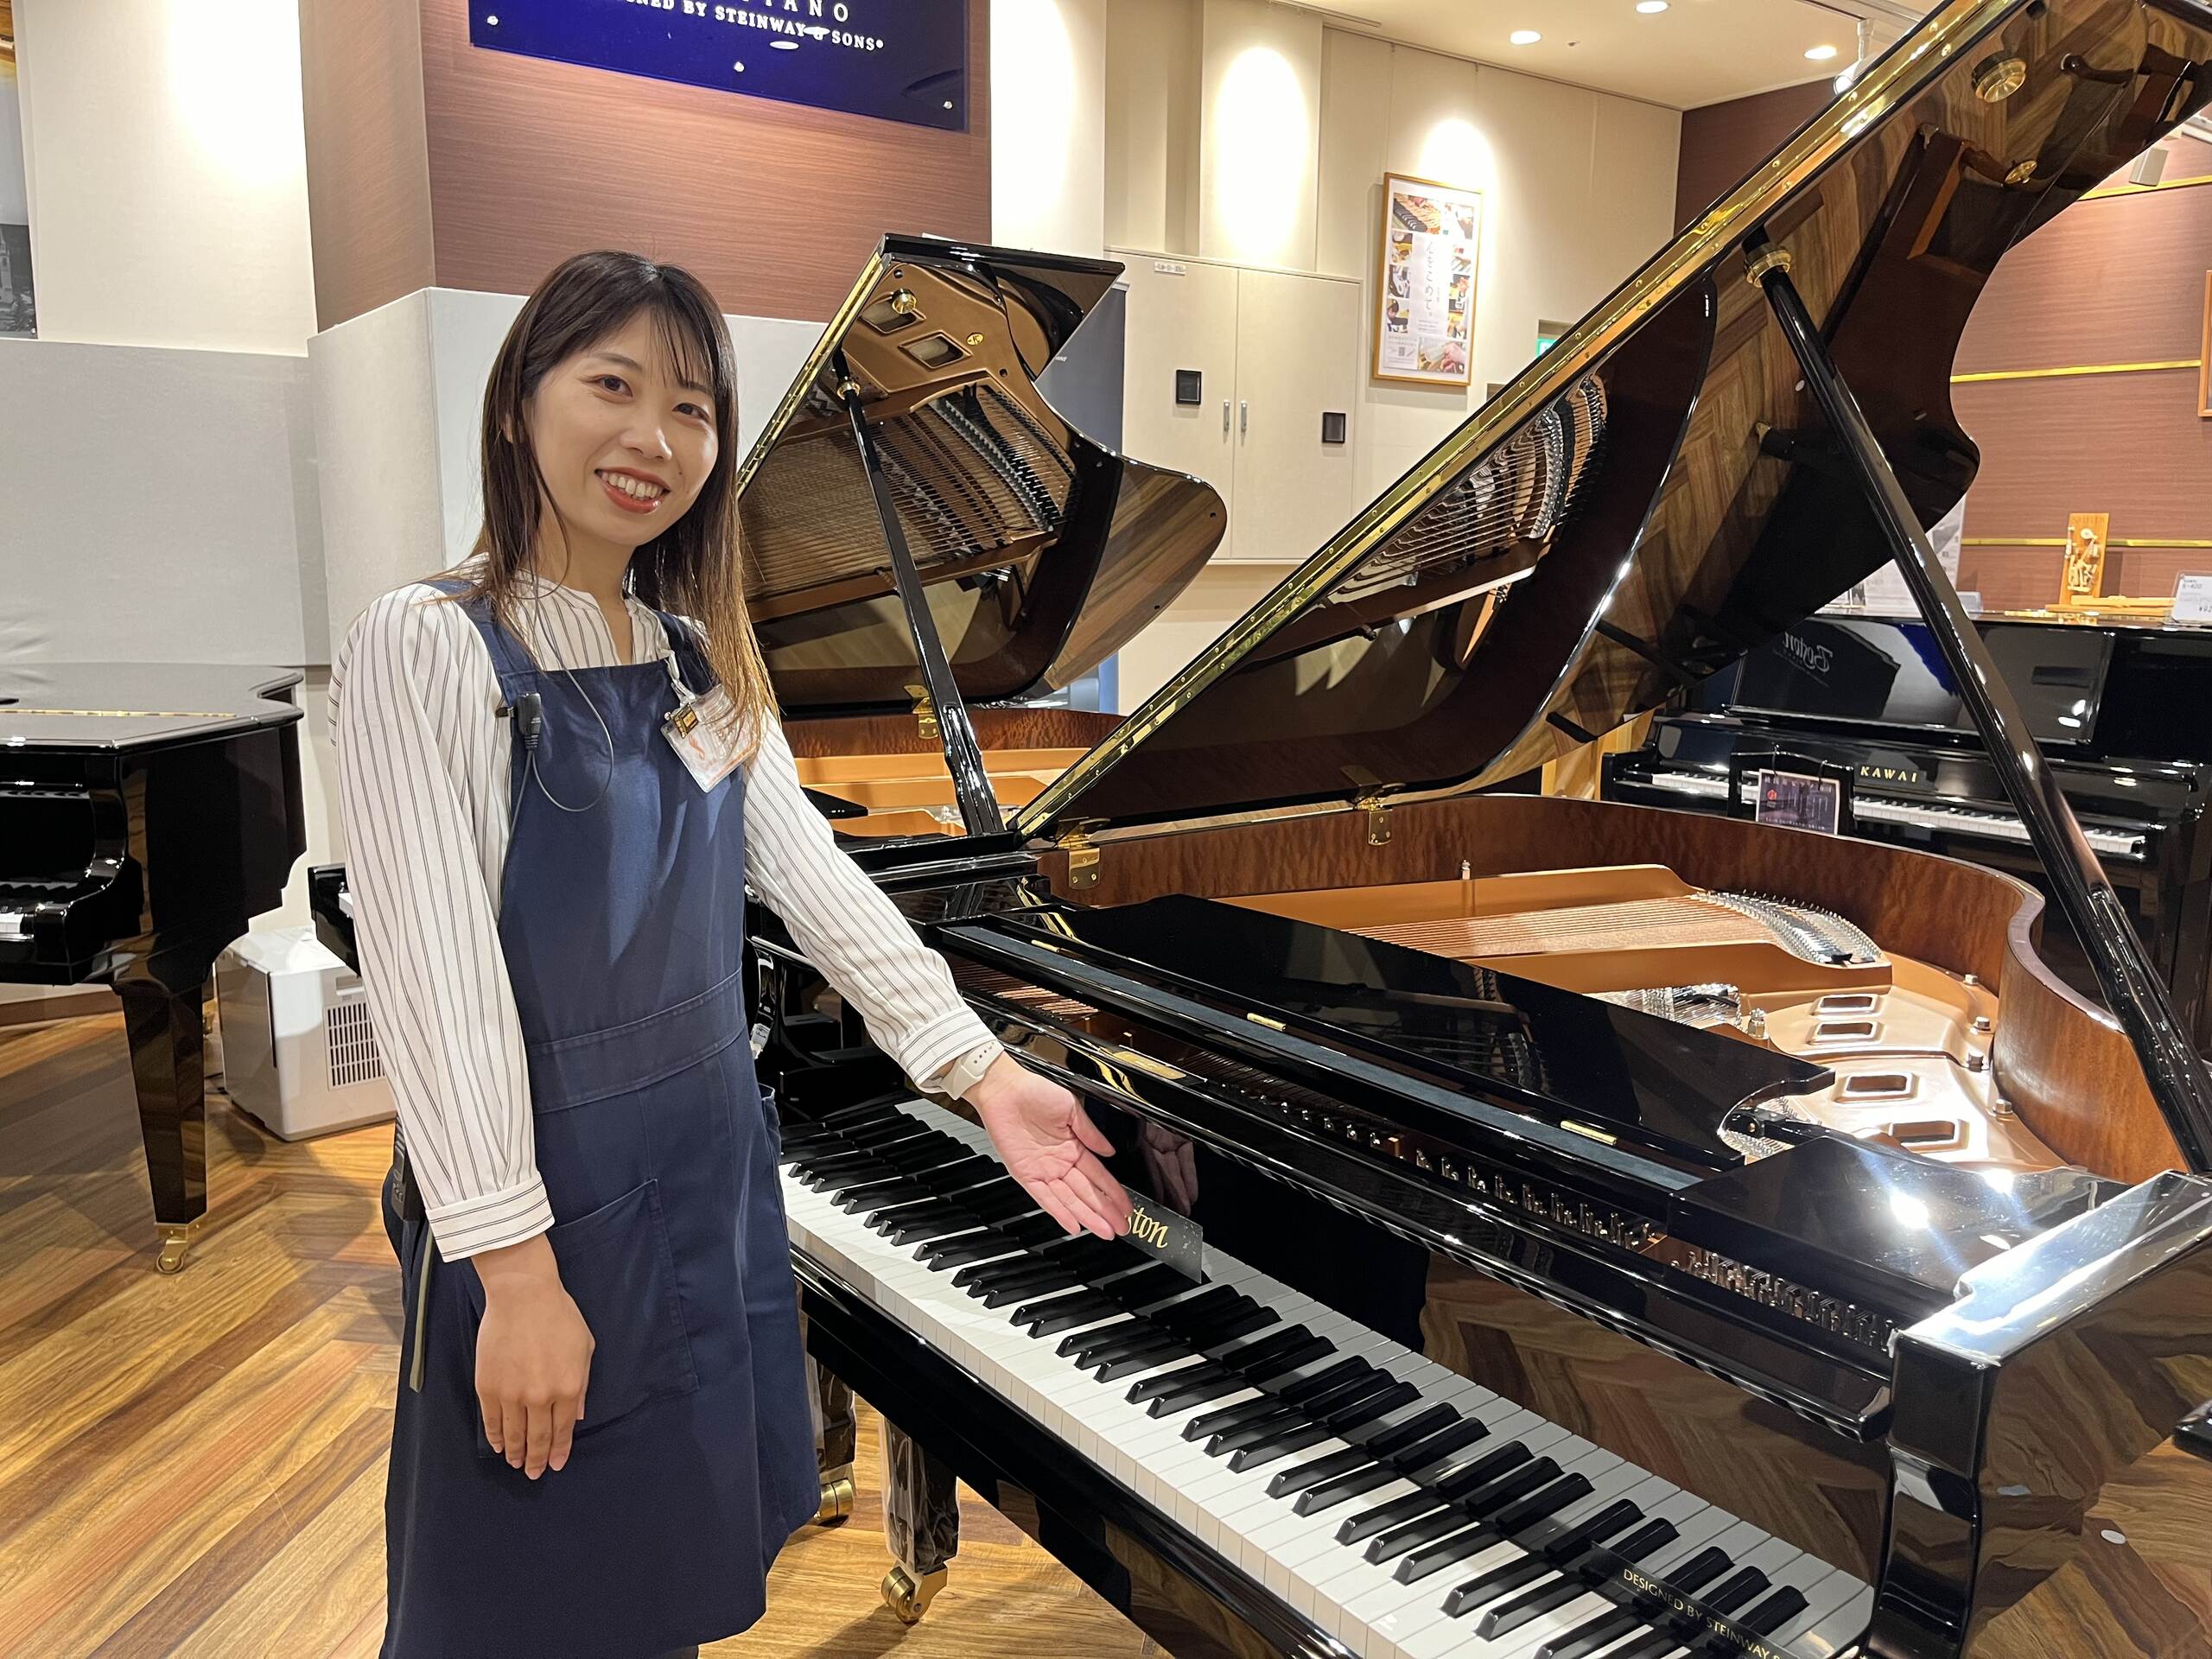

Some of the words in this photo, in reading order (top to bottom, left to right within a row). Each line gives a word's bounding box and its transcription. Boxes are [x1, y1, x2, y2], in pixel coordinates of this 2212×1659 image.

[683, 0, 708, 17] BY
[715, 5, 806, 37] STEINWAY
[743, 0, 849, 22] ANO
[1860, 766, 1917, 783] KAWAI
[1623, 1567, 1684, 1611] DESIGNED
[1687, 1605, 1703, 1622] BY
[1706, 1617, 1770, 1659] STEINWAY
